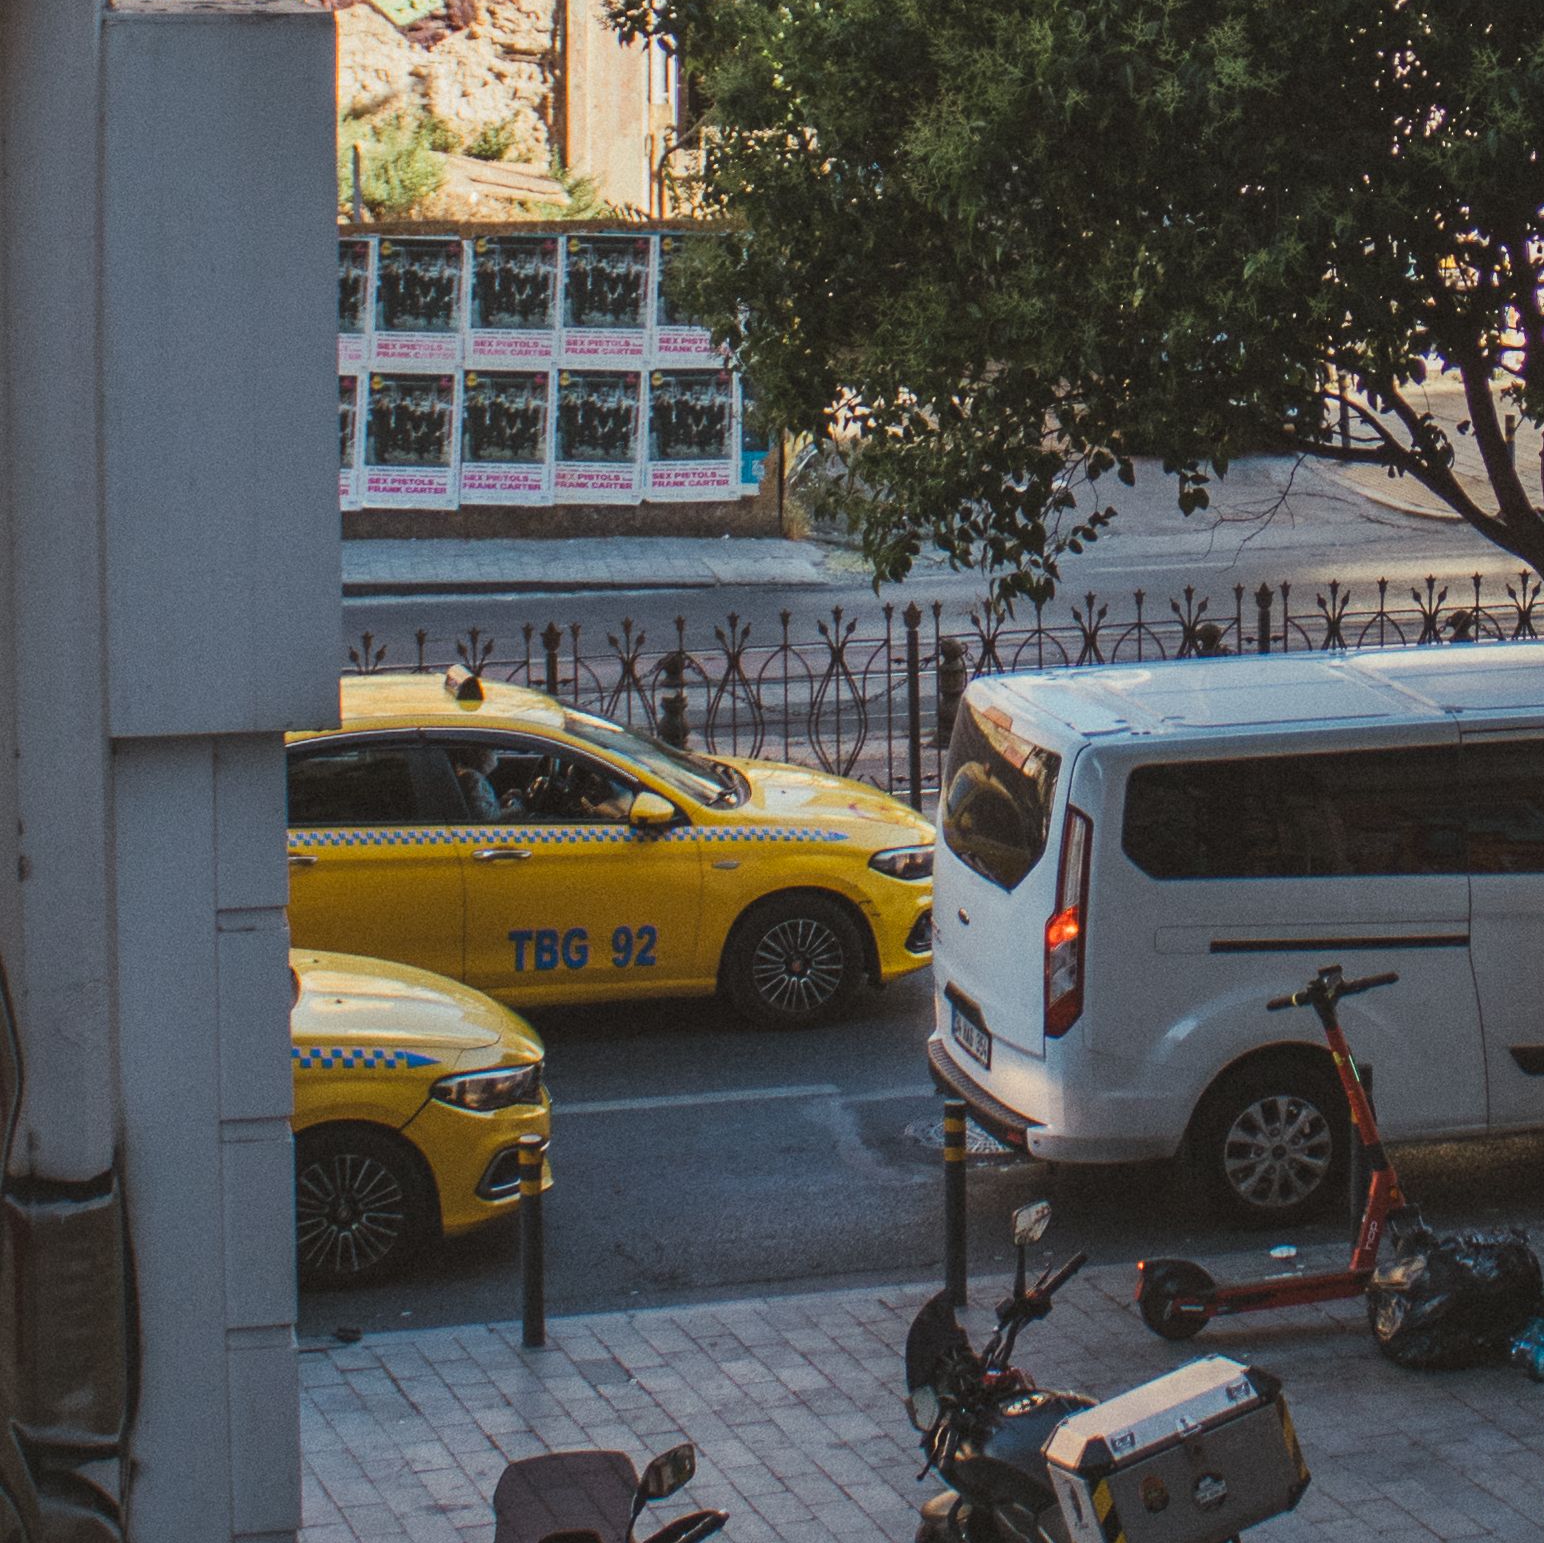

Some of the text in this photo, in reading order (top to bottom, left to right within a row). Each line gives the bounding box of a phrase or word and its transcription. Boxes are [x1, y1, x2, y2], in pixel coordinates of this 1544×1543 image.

[652, 471, 717, 479] SEX PISTOLS
[391, 478, 434, 486] PISTOLS
[688, 479, 729, 487] CARTER
[405, 486, 447, 494] CARTER
[507, 923, 657, 973] TBG 92
